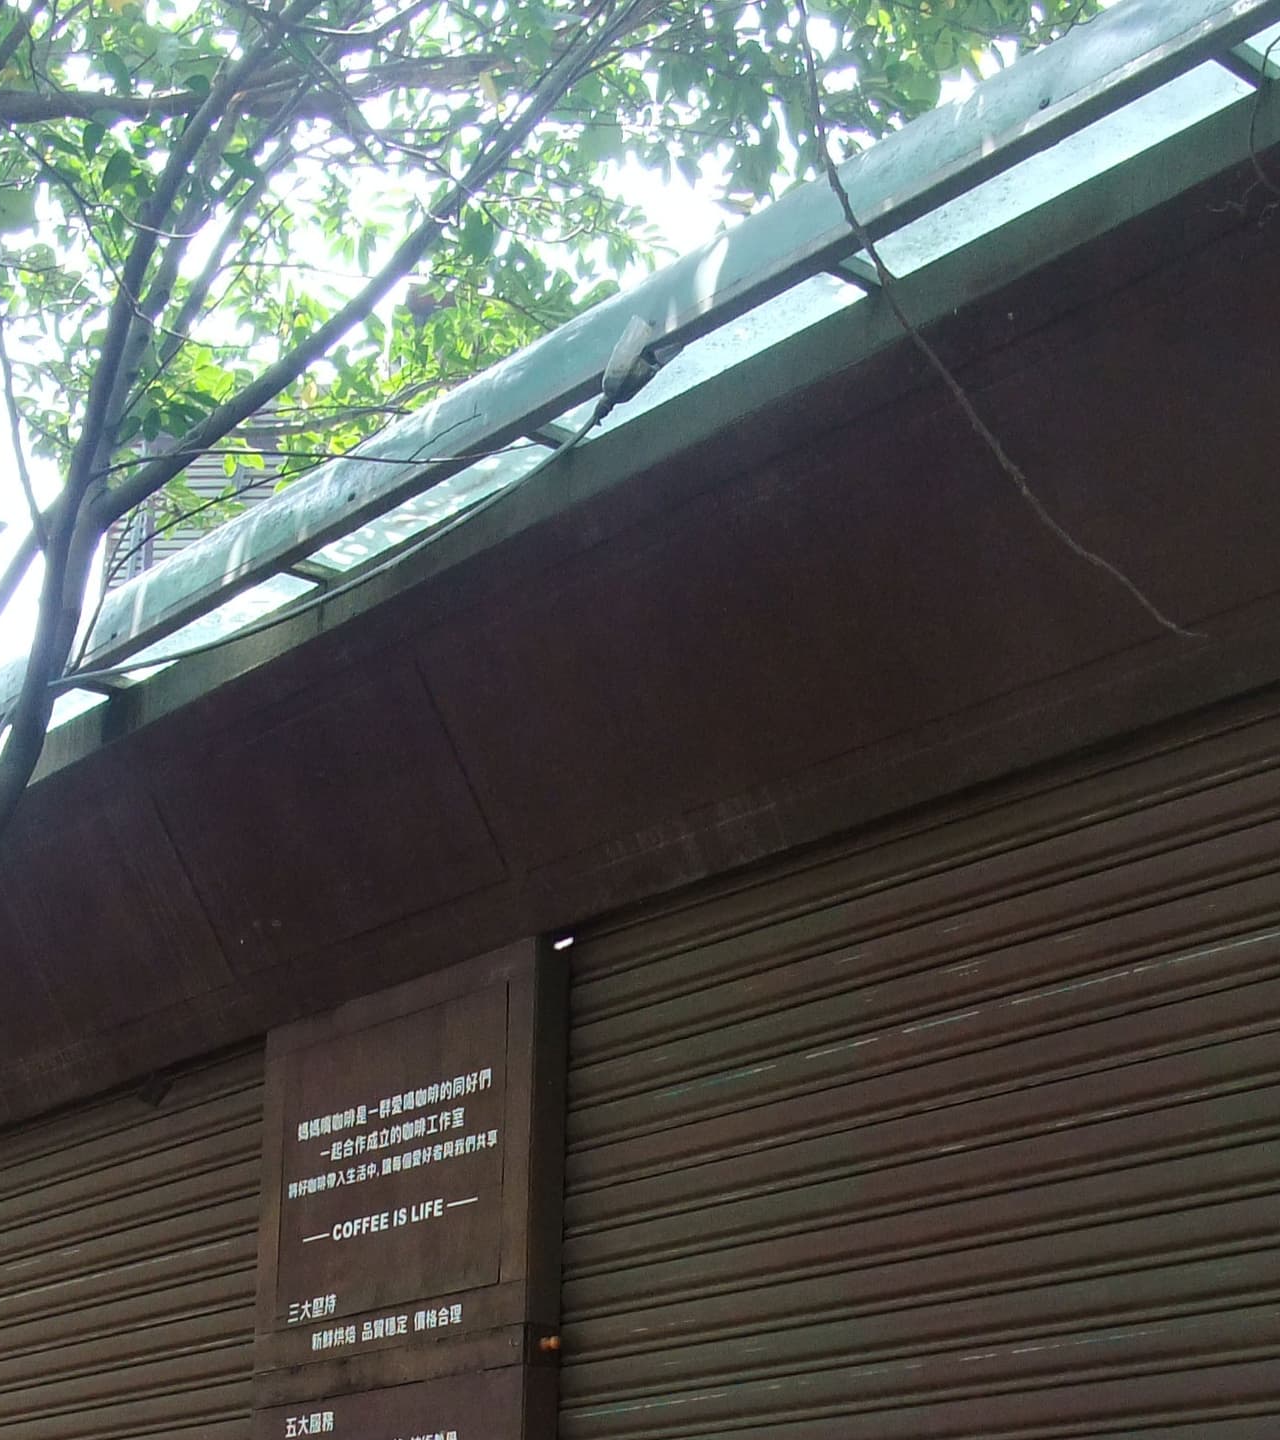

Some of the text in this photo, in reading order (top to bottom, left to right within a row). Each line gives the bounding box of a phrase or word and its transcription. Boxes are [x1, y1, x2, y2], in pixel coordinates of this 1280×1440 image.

[320, 1107, 465, 1161] 一起合作成立的咖啡工作室
[332, 1198, 444, 1241] COFFEE IS LIFE
[287, 1294, 337, 1324] 三大堅持
[362, 1315, 408, 1342] 品質穩定
[414, 1304, 462, 1332] 價格合理
[285, 1411, 334, 1438] 五大服務
